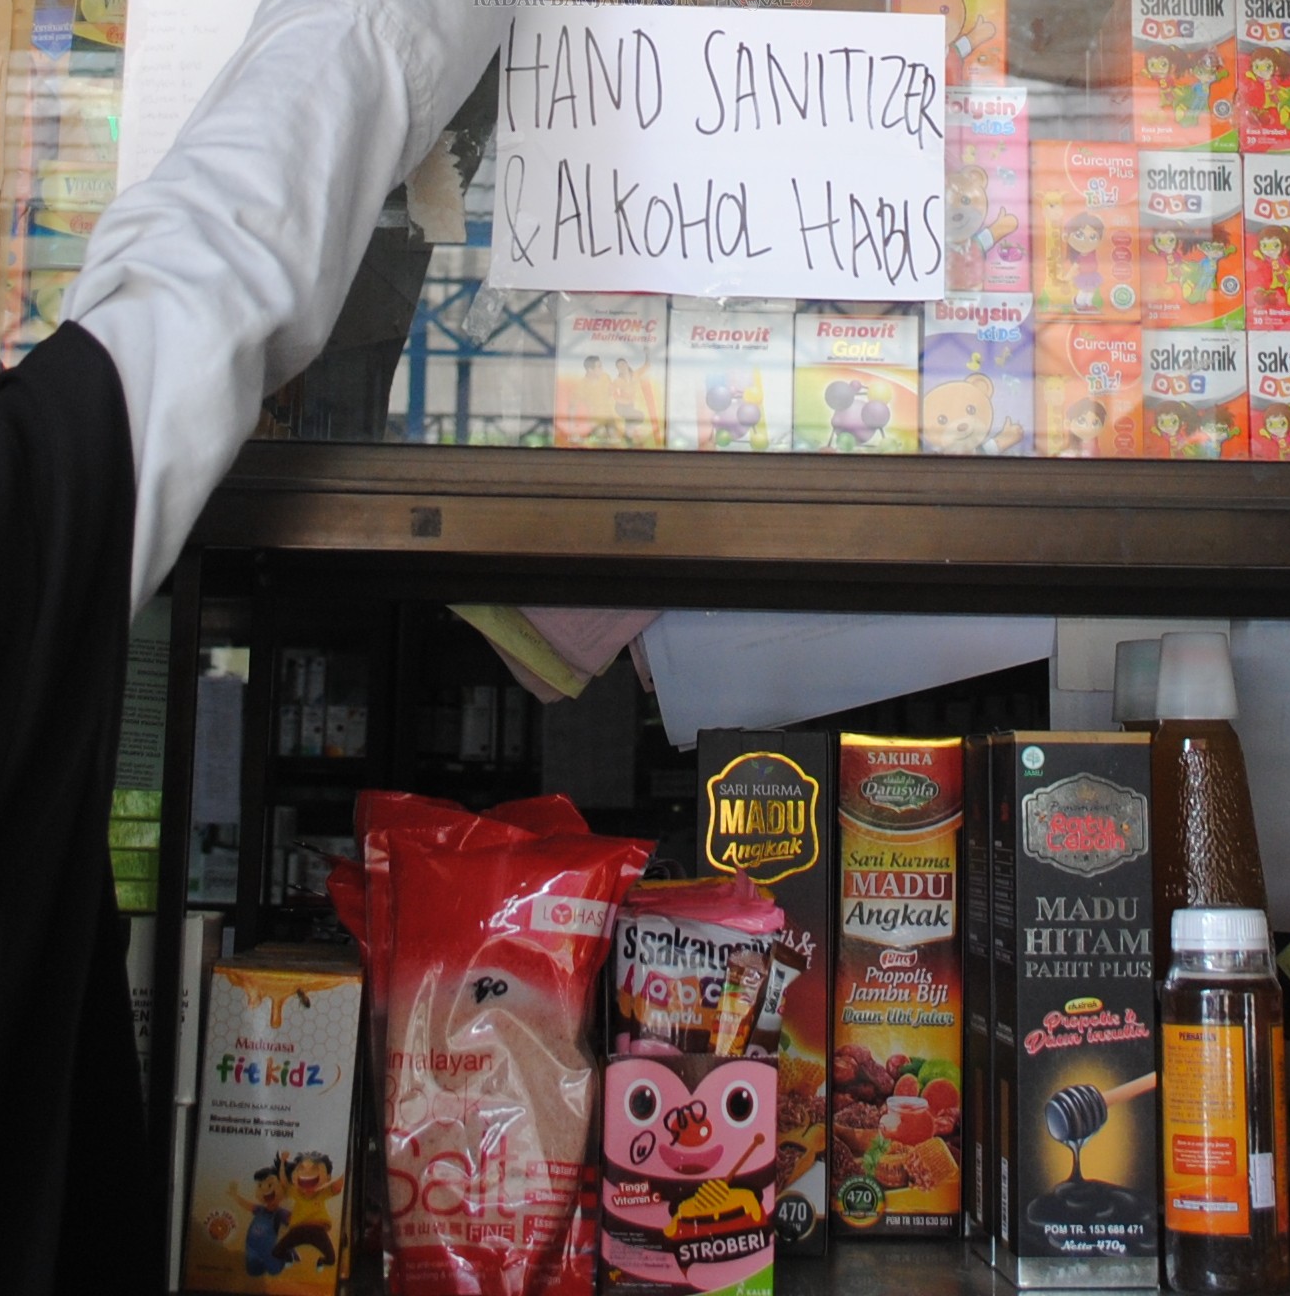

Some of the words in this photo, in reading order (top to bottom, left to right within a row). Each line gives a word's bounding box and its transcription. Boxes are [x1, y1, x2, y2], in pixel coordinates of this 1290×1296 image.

[506, 16, 663, 133] HAND
[696, 29, 944, 150] SANITIZER
[1071, 154, 1135, 169] Curcuma
[1109, 166, 1135, 179] Plus
[1147, 163, 1233, 196] sakatonik
[553, 158, 772, 264] ALKOHOL
[792, 178, 942, 286] HABIS
[934, 300, 1022, 323] Biolysin
[690, 324, 771, 344] Renovit
[832, 338, 881, 359] Gold
[867, 751, 933, 766] SAKURA
[719, 782, 749, 797] SARI
[751, 782, 802, 797] KURMA
[719, 799, 805, 835] MADU
[722, 836, 802, 869] Angkak
[846, 851, 887, 870] Sari
[891, 852, 951, 870] Kurma
[850, 871, 947, 899] MADU
[845, 902, 949, 932] Angkak
[1035, 895, 1139, 924] MADU
[1024, 928, 1152, 956] HITAM
[865, 966, 934, 986] Propolis
[1025, 959, 1095, 979] PAHIT
[1098, 959, 1153, 979] PLUS
[846, 982, 910, 1004] Jambu
[915, 984, 949, 1004] Biji
[235, 1035, 295, 1054] Madurasa
[619, 1182, 649, 1194] Tinggi
[613, 1193, 650, 1206] Vitamin
[652, 1193, 661, 1205] C
[467, 1224, 515, 1242] FINE
[679, 1233, 767, 1262] STROBERI
